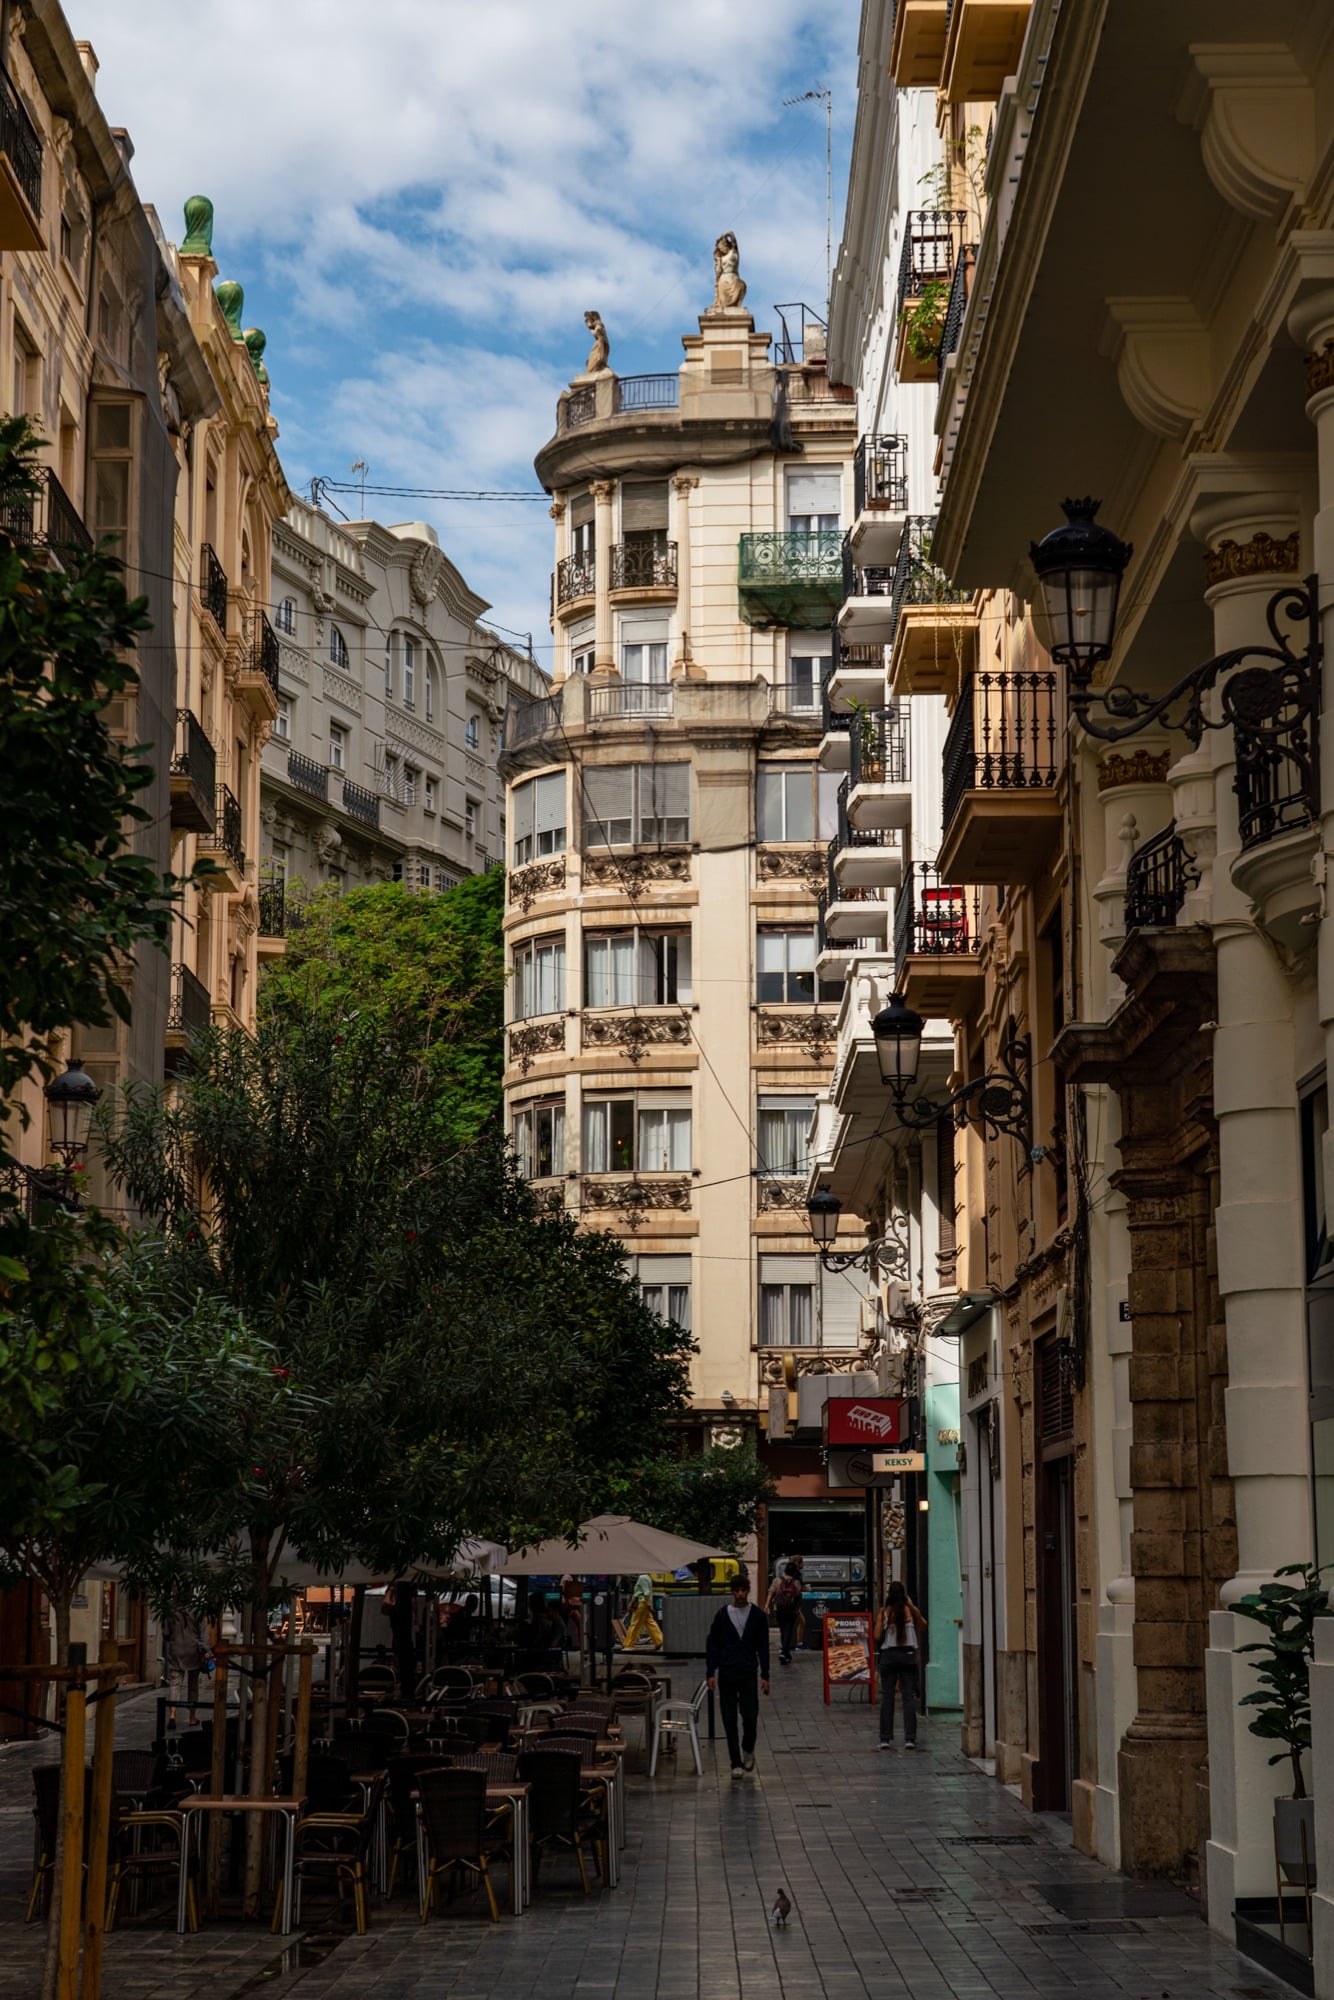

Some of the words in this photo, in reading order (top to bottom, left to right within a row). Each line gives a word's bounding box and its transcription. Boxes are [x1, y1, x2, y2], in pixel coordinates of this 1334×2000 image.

[853, 1408, 871, 1418] UNO
[848, 1416, 881, 1437] MIGA
[885, 1458, 913, 1466] KEKSY
